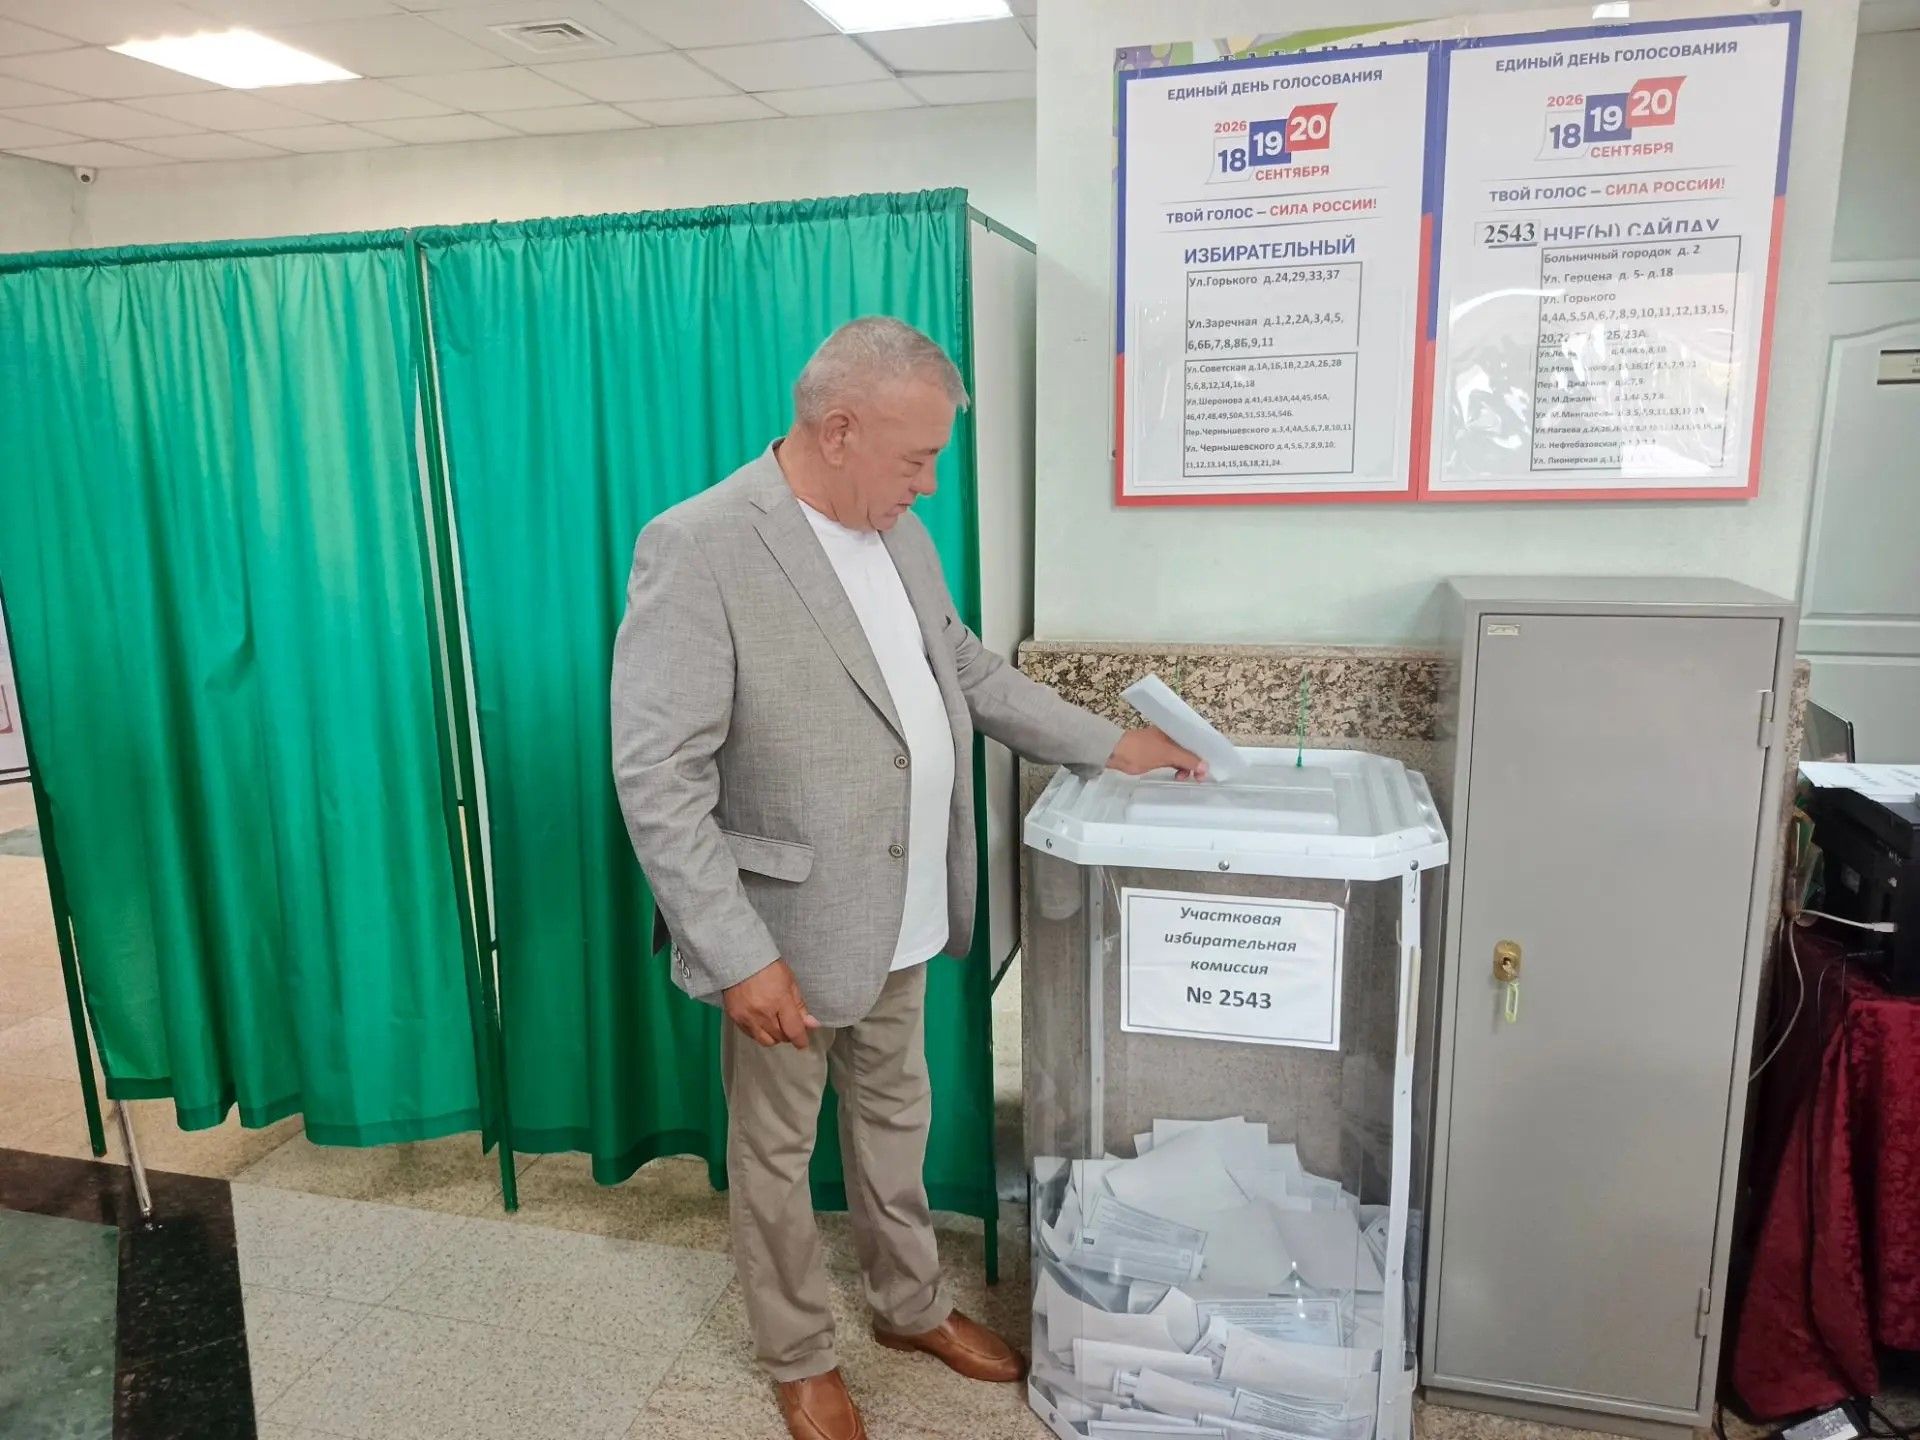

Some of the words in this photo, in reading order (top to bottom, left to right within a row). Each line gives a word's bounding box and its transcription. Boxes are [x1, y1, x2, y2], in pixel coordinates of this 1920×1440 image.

[1496, 52, 1564, 72] ЕДИНЫЙ
[1567, 51, 1610, 69] ДЕНЬ
[1614, 40, 1738, 64] ГОЛОСОВАНИЯ
[1167, 82, 1228, 101] ЕДИНЫЙ
[1231, 80, 1270, 97] ДЕНЬ
[1273, 70, 1383, 91] ГОЛОСОВАНИЯ
[1546, 94, 1584, 108] 2026
[1214, 120, 1248, 134] 2026
[1549, 123, 1581, 150] 18
[1590, 105, 1623, 133] 19
[1632, 88, 1673, 117] 20
[1218, 147, 1246, 173] 18
[1253, 130, 1283, 157] 19
[1290, 114, 1327, 142] 20
[1590, 142, 1674, 158] СЕНТЯБРЯ
[1255, 165, 1330, 181] СЕНТЯБРЯ
[1489, 186, 1531, 203] ТВОЙ
[1534, 184, 1587, 200] ГОЛОС
[1605, 180, 1649, 196] СИЛА
[1653, 177, 1726, 194] РОССИИ!
[1166, 209, 1204, 224] ТВОЙ
[1206, 207, 1254, 222] ГОЛОС
[1270, 202, 1309, 217] СИЛА
[1313, 198, 1378, 214] РОССИИ!
[1484, 222, 1535, 244] 2543
[1184, 234, 1356, 264] ИЗБИРАТЕЛЬНЫЙ
[1544, 248, 1618, 264] Больничный
[1622, 246, 1672, 260] городок
[1677, 246, 1690, 257] д.
[1692, 244, 1700, 254] 2
[1190, 276, 1258, 288] Ул.Горького
[1263, 270, 1340, 286] д.24,29,33,37
[1543, 274, 1560, 286] Ул.
[1564, 272, 1612, 284] Герцена
[1618, 272, 1632, 282] д.
[1647, 268, 1674, 280] д.18
[1563, 292, 1616, 304] Горького
[1188, 318, 1258, 329] Ул.Заречная
[1200, 443, 1275, 452] Чернышевского
[1178, 906, 1282, 926] Участковая
[1164, 932, 1297, 953] избирательная
[1190, 958, 1269, 976] комиссия
[1186, 986, 1212, 1005] №
[1218, 989, 1272, 1010] 2543
